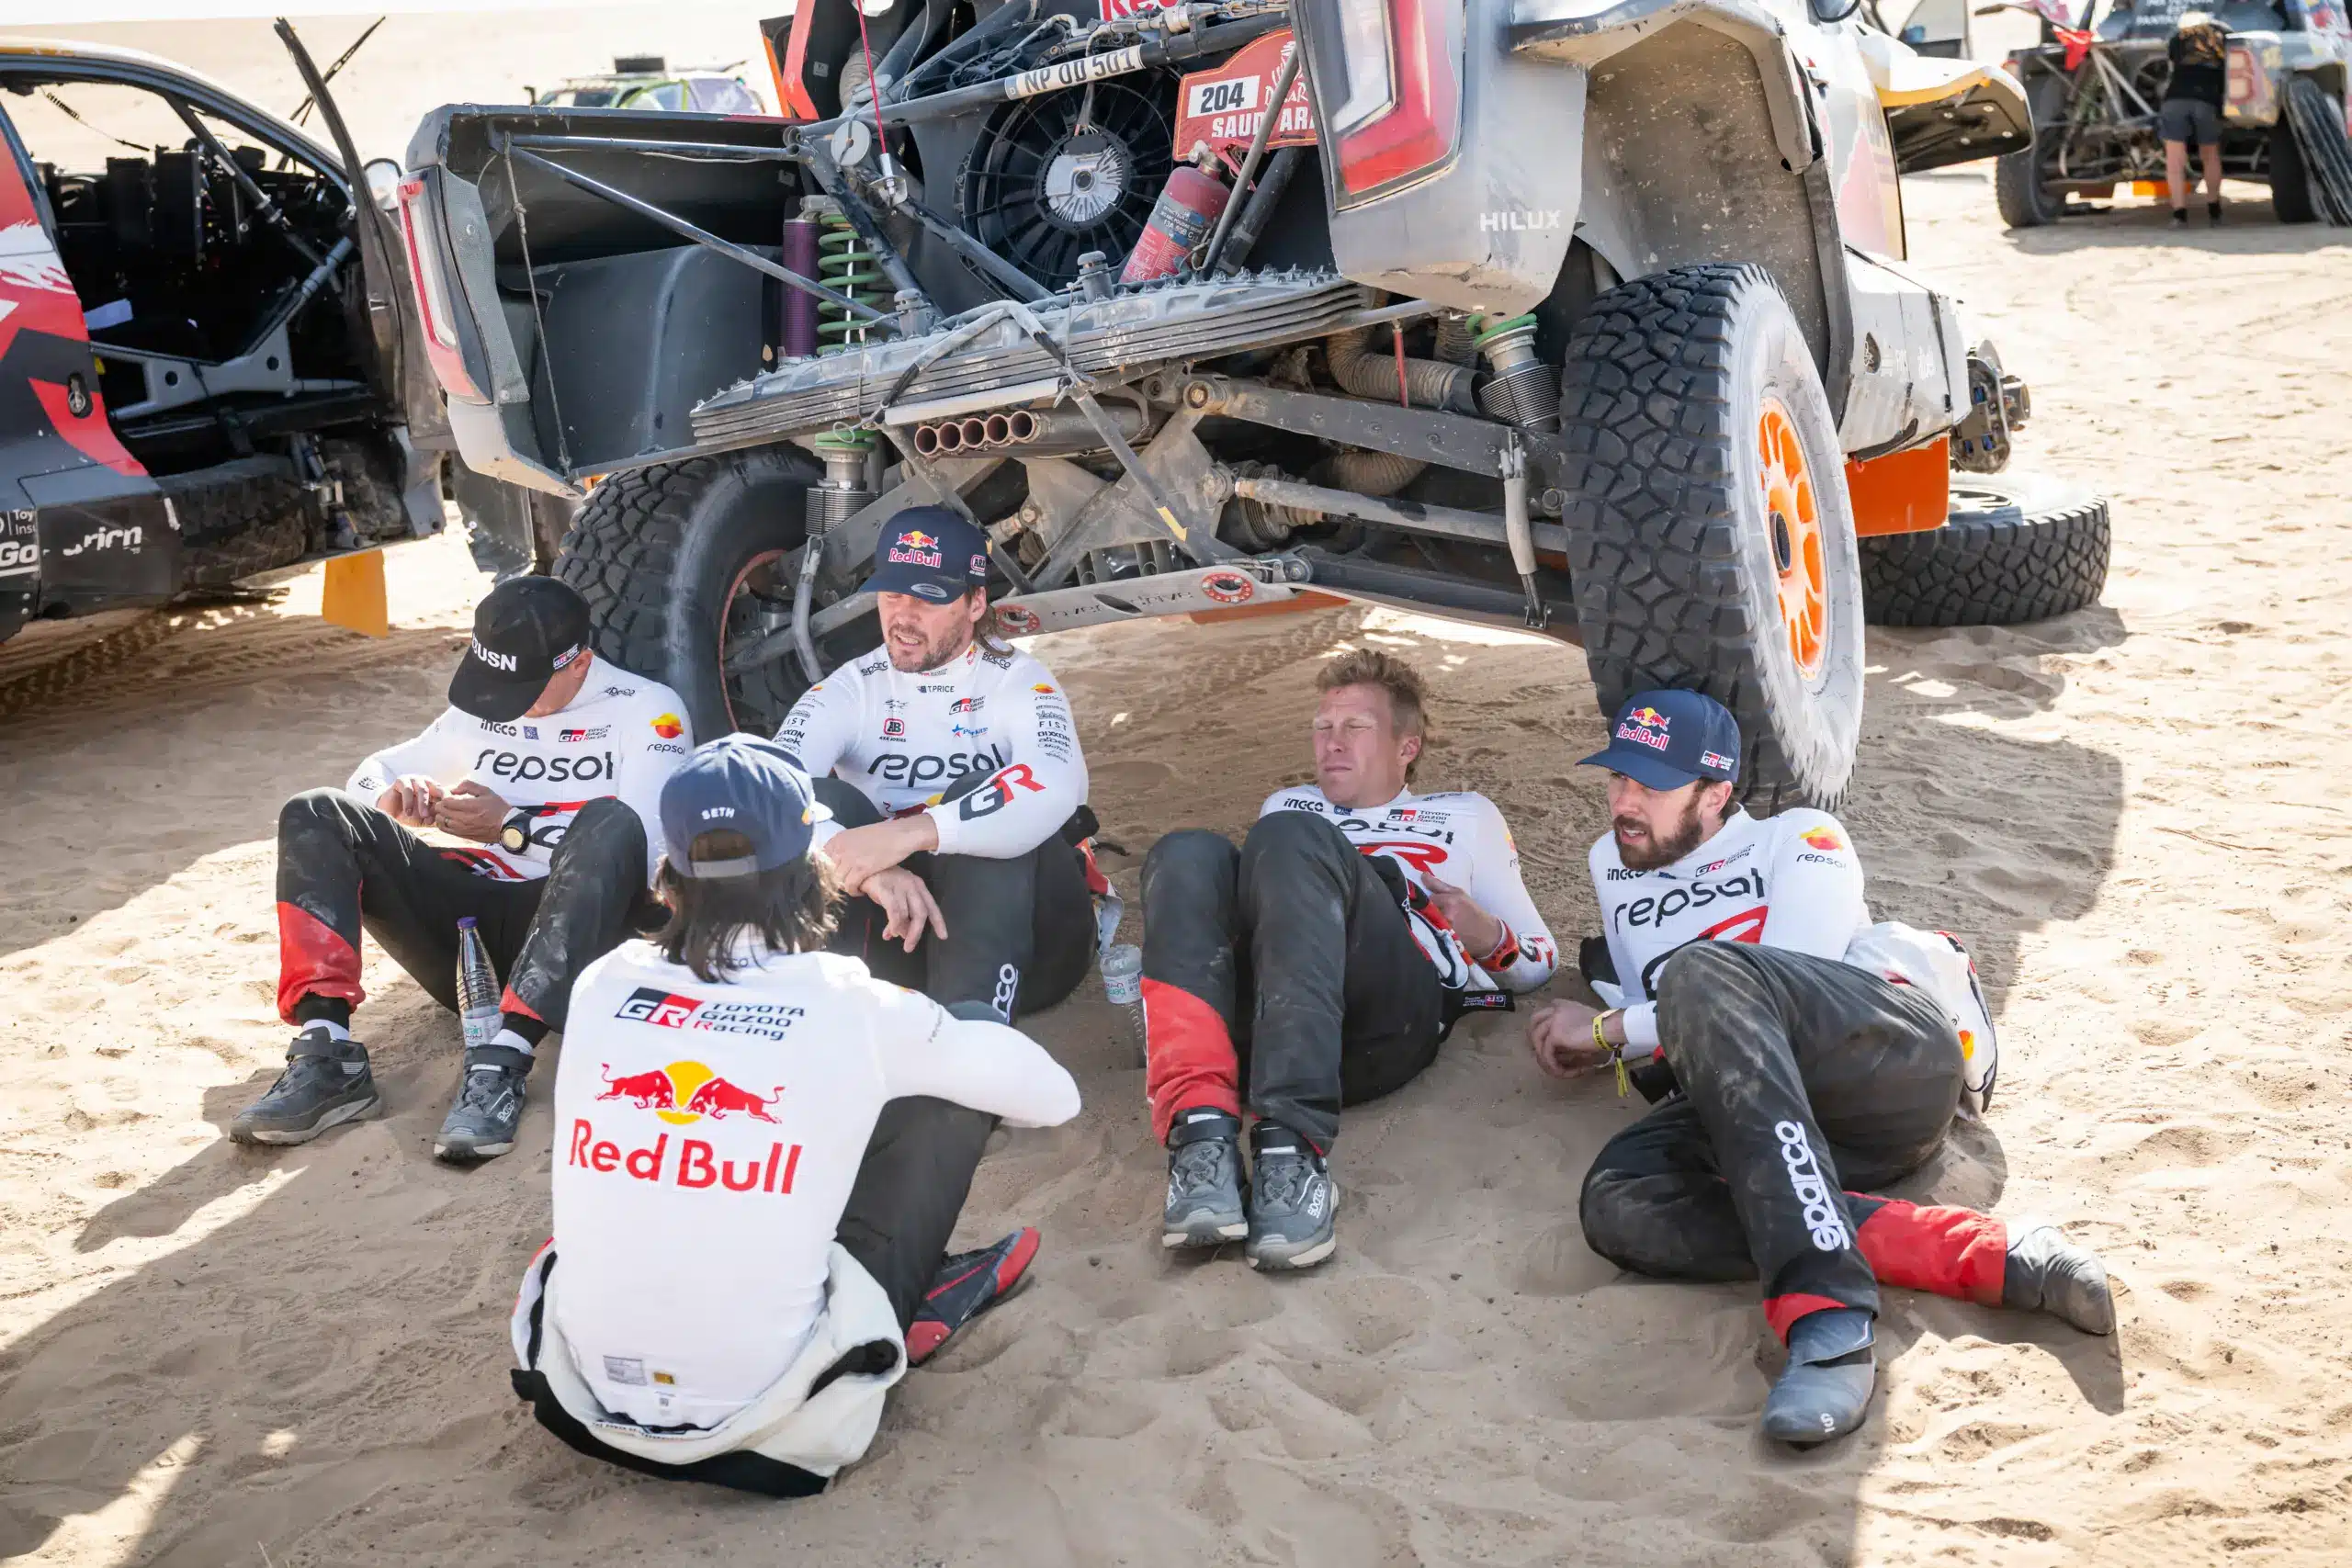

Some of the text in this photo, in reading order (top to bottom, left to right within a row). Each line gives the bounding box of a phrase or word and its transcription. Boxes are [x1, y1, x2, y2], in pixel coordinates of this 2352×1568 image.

[1023, 67, 1051, 94] NP
[1092, 50, 1136, 77] 501
[1201, 82, 1245, 114] 204
[1479, 209, 1562, 231] HILUX
[888, 547, 942, 568] Red Bull
[477, 642, 517, 672] USN
[927, 685, 955, 694] T.PRICE
[647, 743, 686, 755] repsol
[1616, 723, 1670, 751] Red Bull
[474, 749, 614, 783] repsol
[867, 743, 1007, 788] repsol
[960, 763, 1046, 821] GR
[701, 807, 735, 820] SETH
[1796, 852, 1847, 868] repsol
[1614, 867, 1766, 935] repsol
[616, 996, 805, 1028] GR TOYOTA
[701, 1010, 792, 1028] GAZOO
[694, 1020, 785, 1042] Racing
[570, 1118, 803, 1194] Red Bull
[1775, 1120, 1850, 1252] sparco
